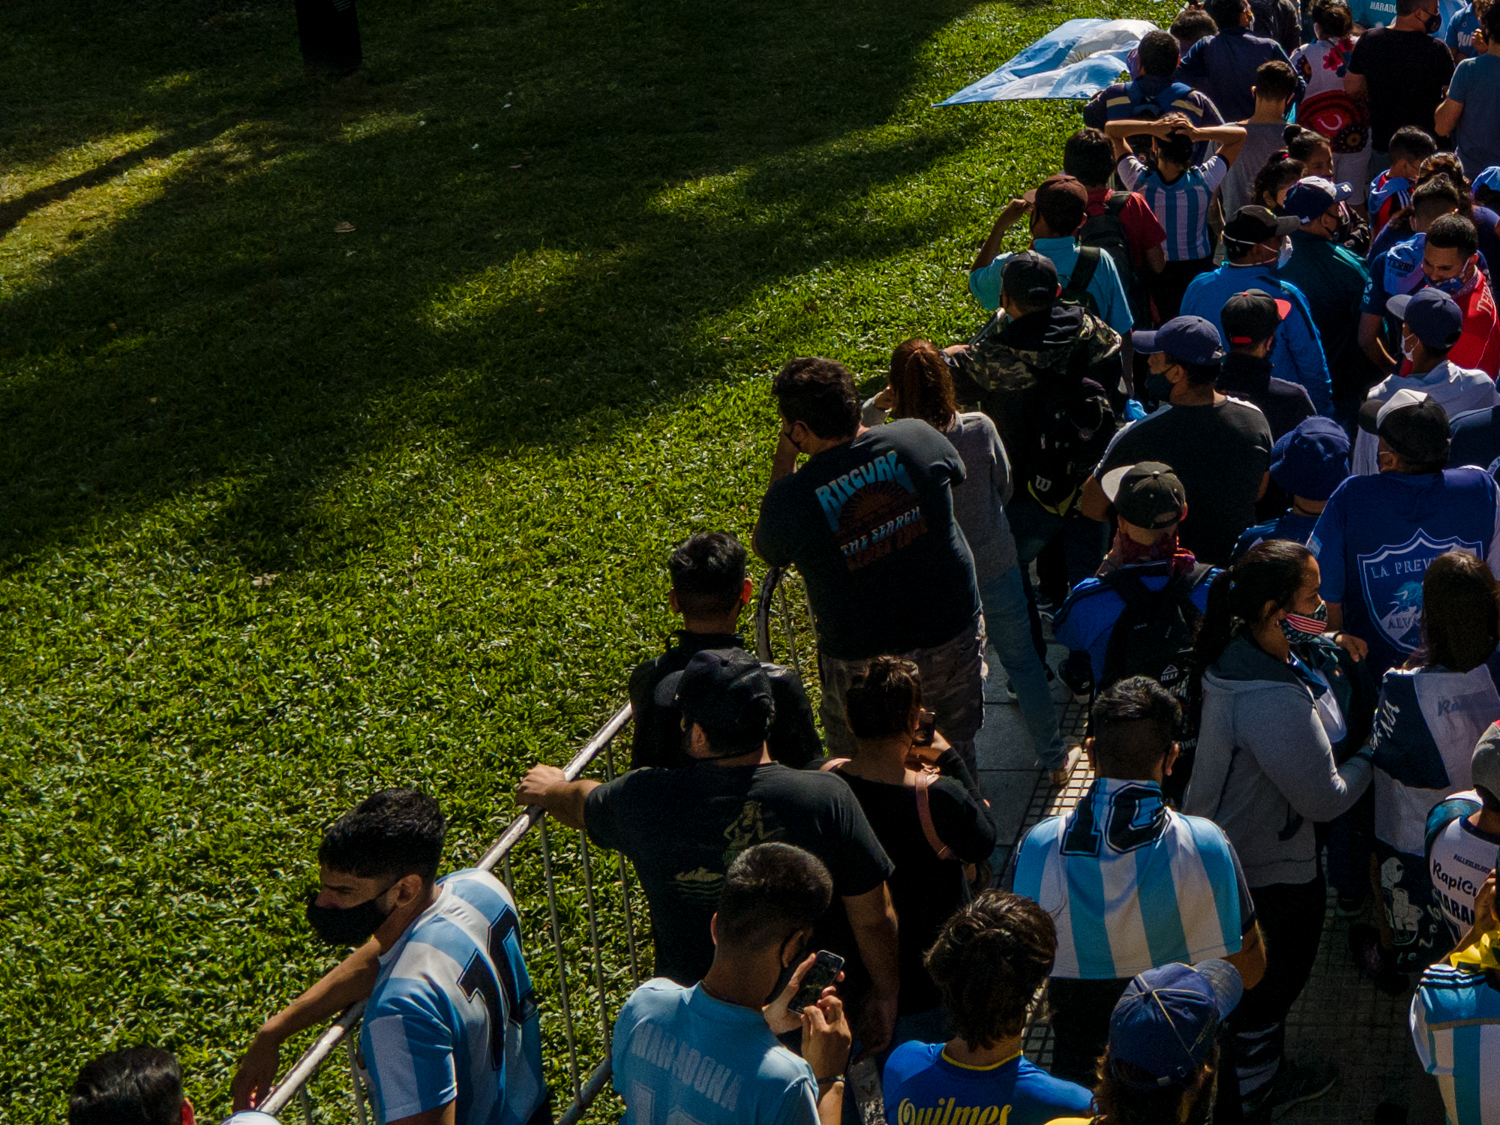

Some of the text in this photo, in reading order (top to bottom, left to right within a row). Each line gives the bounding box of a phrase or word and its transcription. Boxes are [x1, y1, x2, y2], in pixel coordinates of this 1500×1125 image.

[871, 505, 921, 544] SEARCH
[1370, 564, 1390, 579] LA
[630, 1021, 742, 1113] MARADONA
